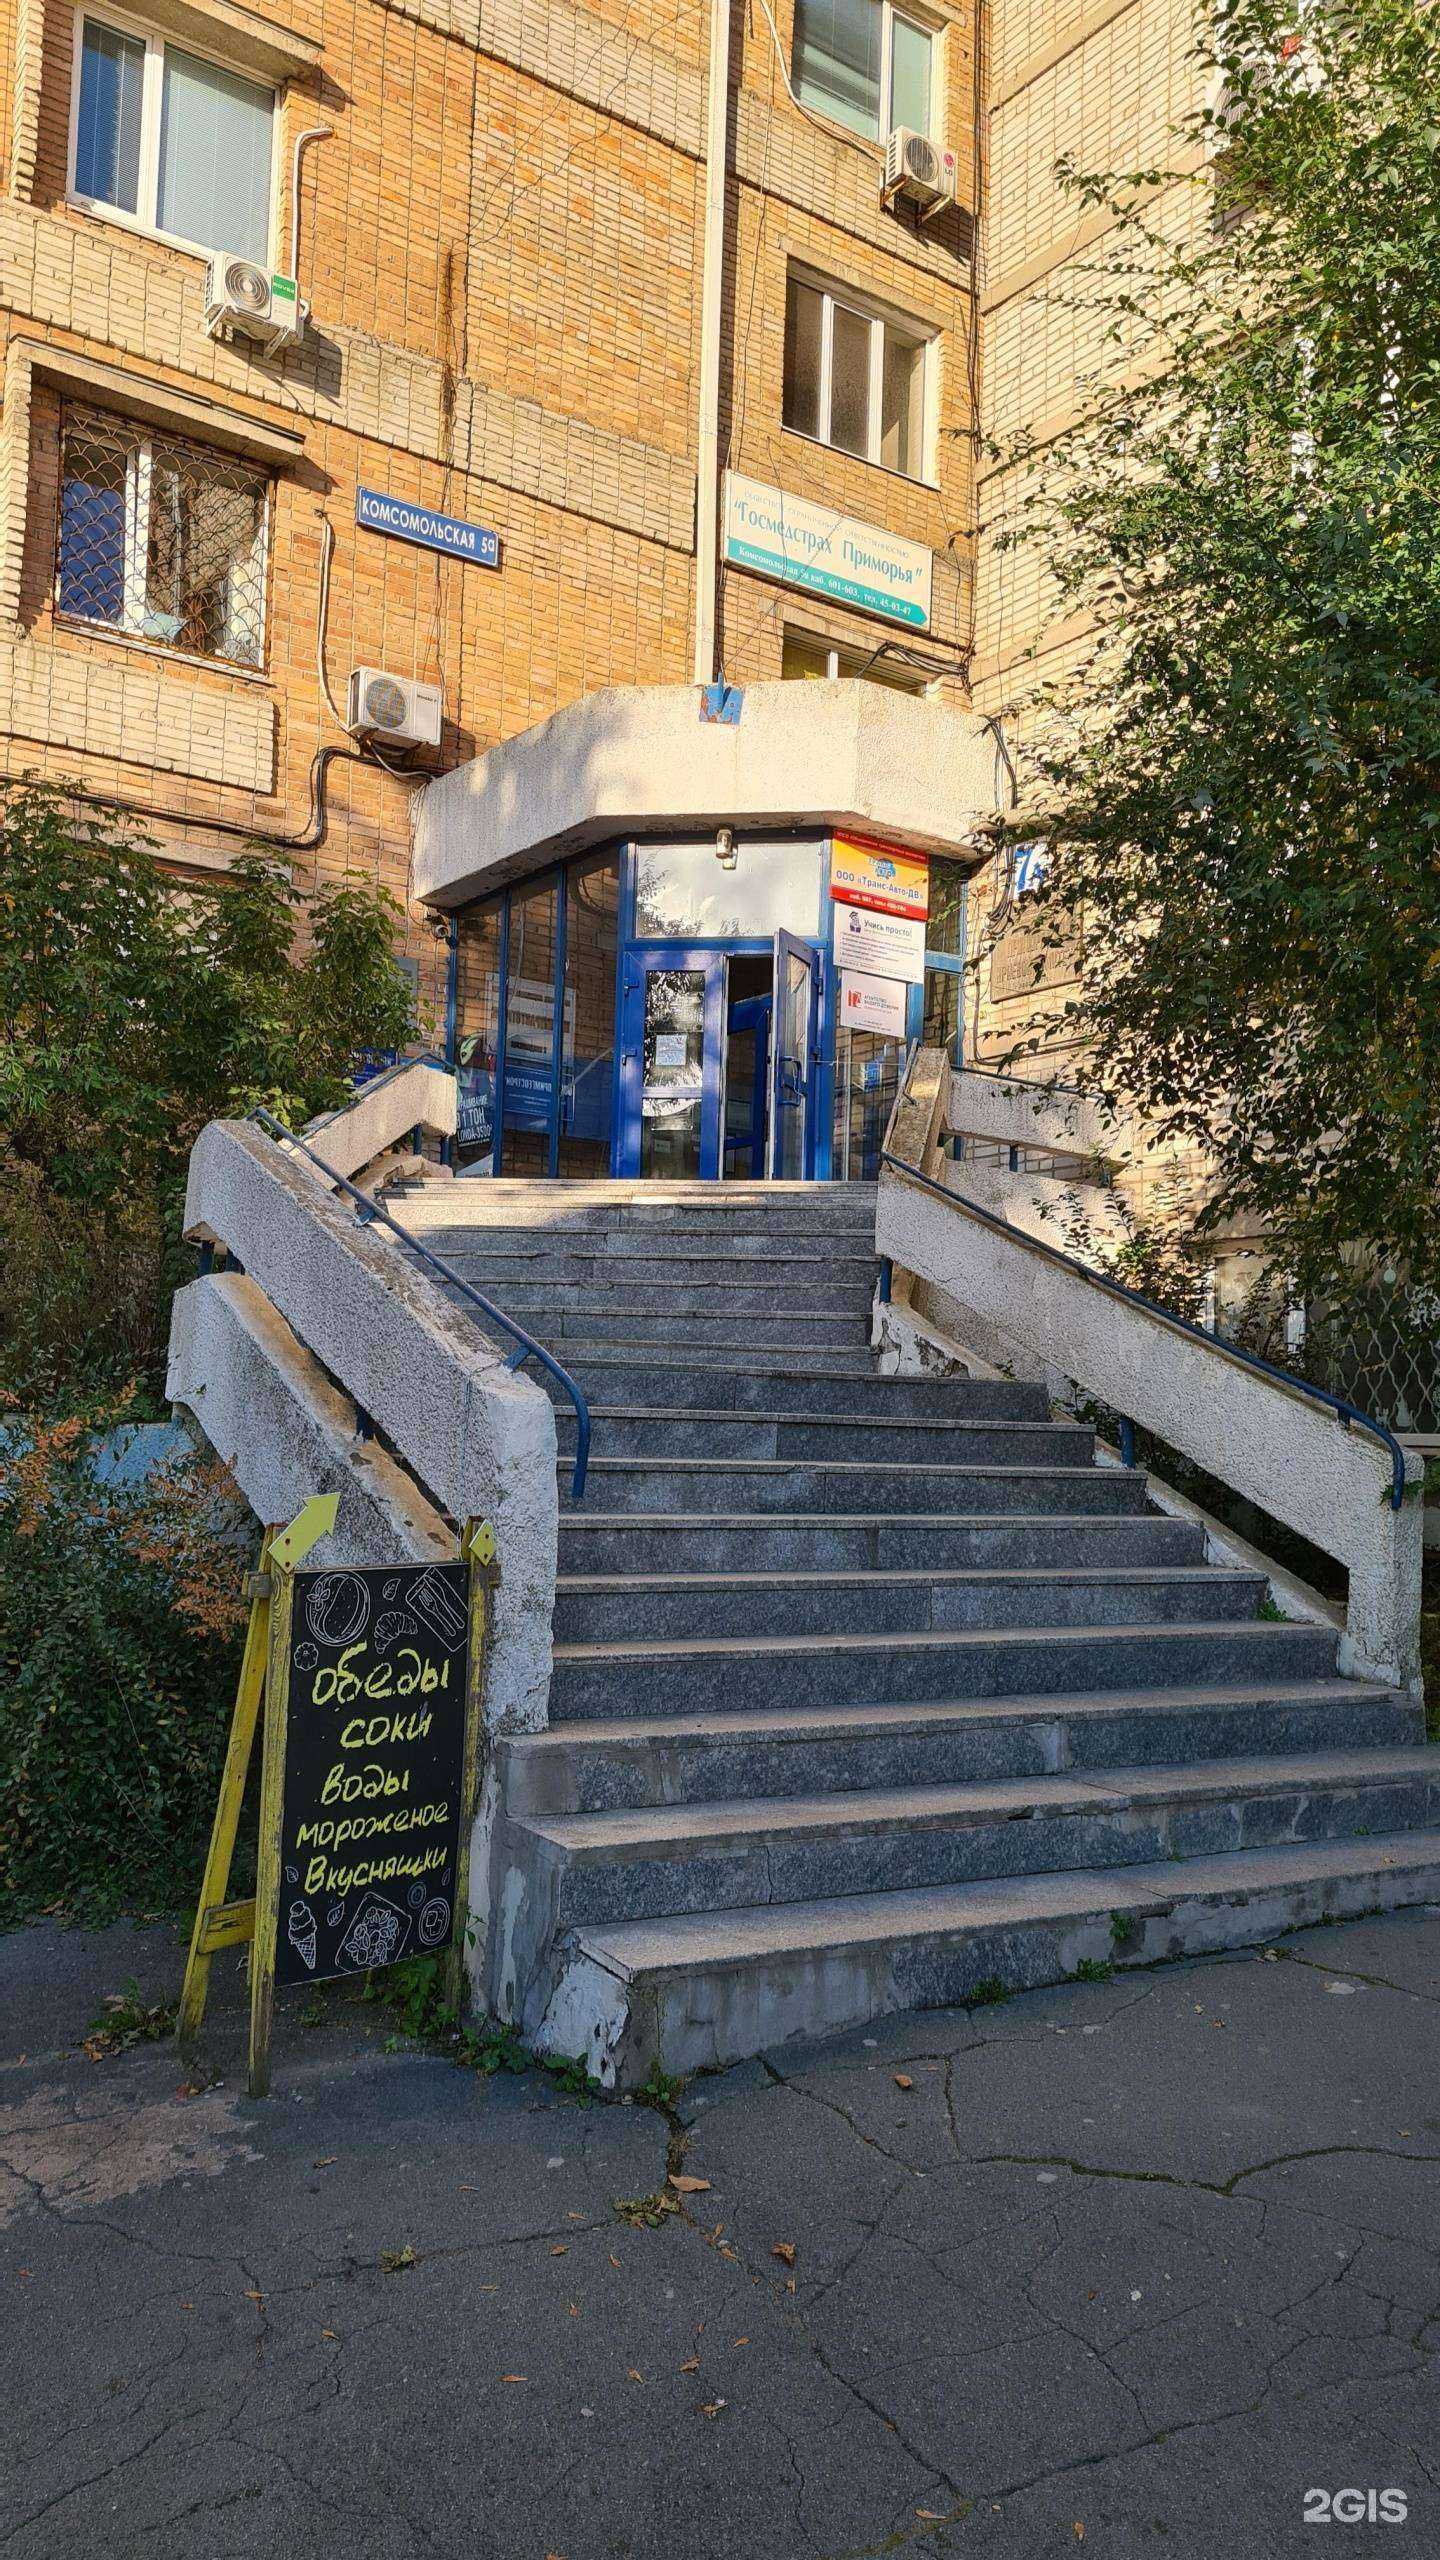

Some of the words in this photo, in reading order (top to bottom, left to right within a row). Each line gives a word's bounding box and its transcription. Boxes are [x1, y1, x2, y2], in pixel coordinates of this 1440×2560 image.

[362, 497, 475, 550] КОМСОМОЛЬСКАЯ
[836, 870, 855, 882] ООО
[864, 919, 884, 931] Учись
[468, 1107, 485, 1126] ТОН
[304, 1847, 447, 1897] Вкусняшки
